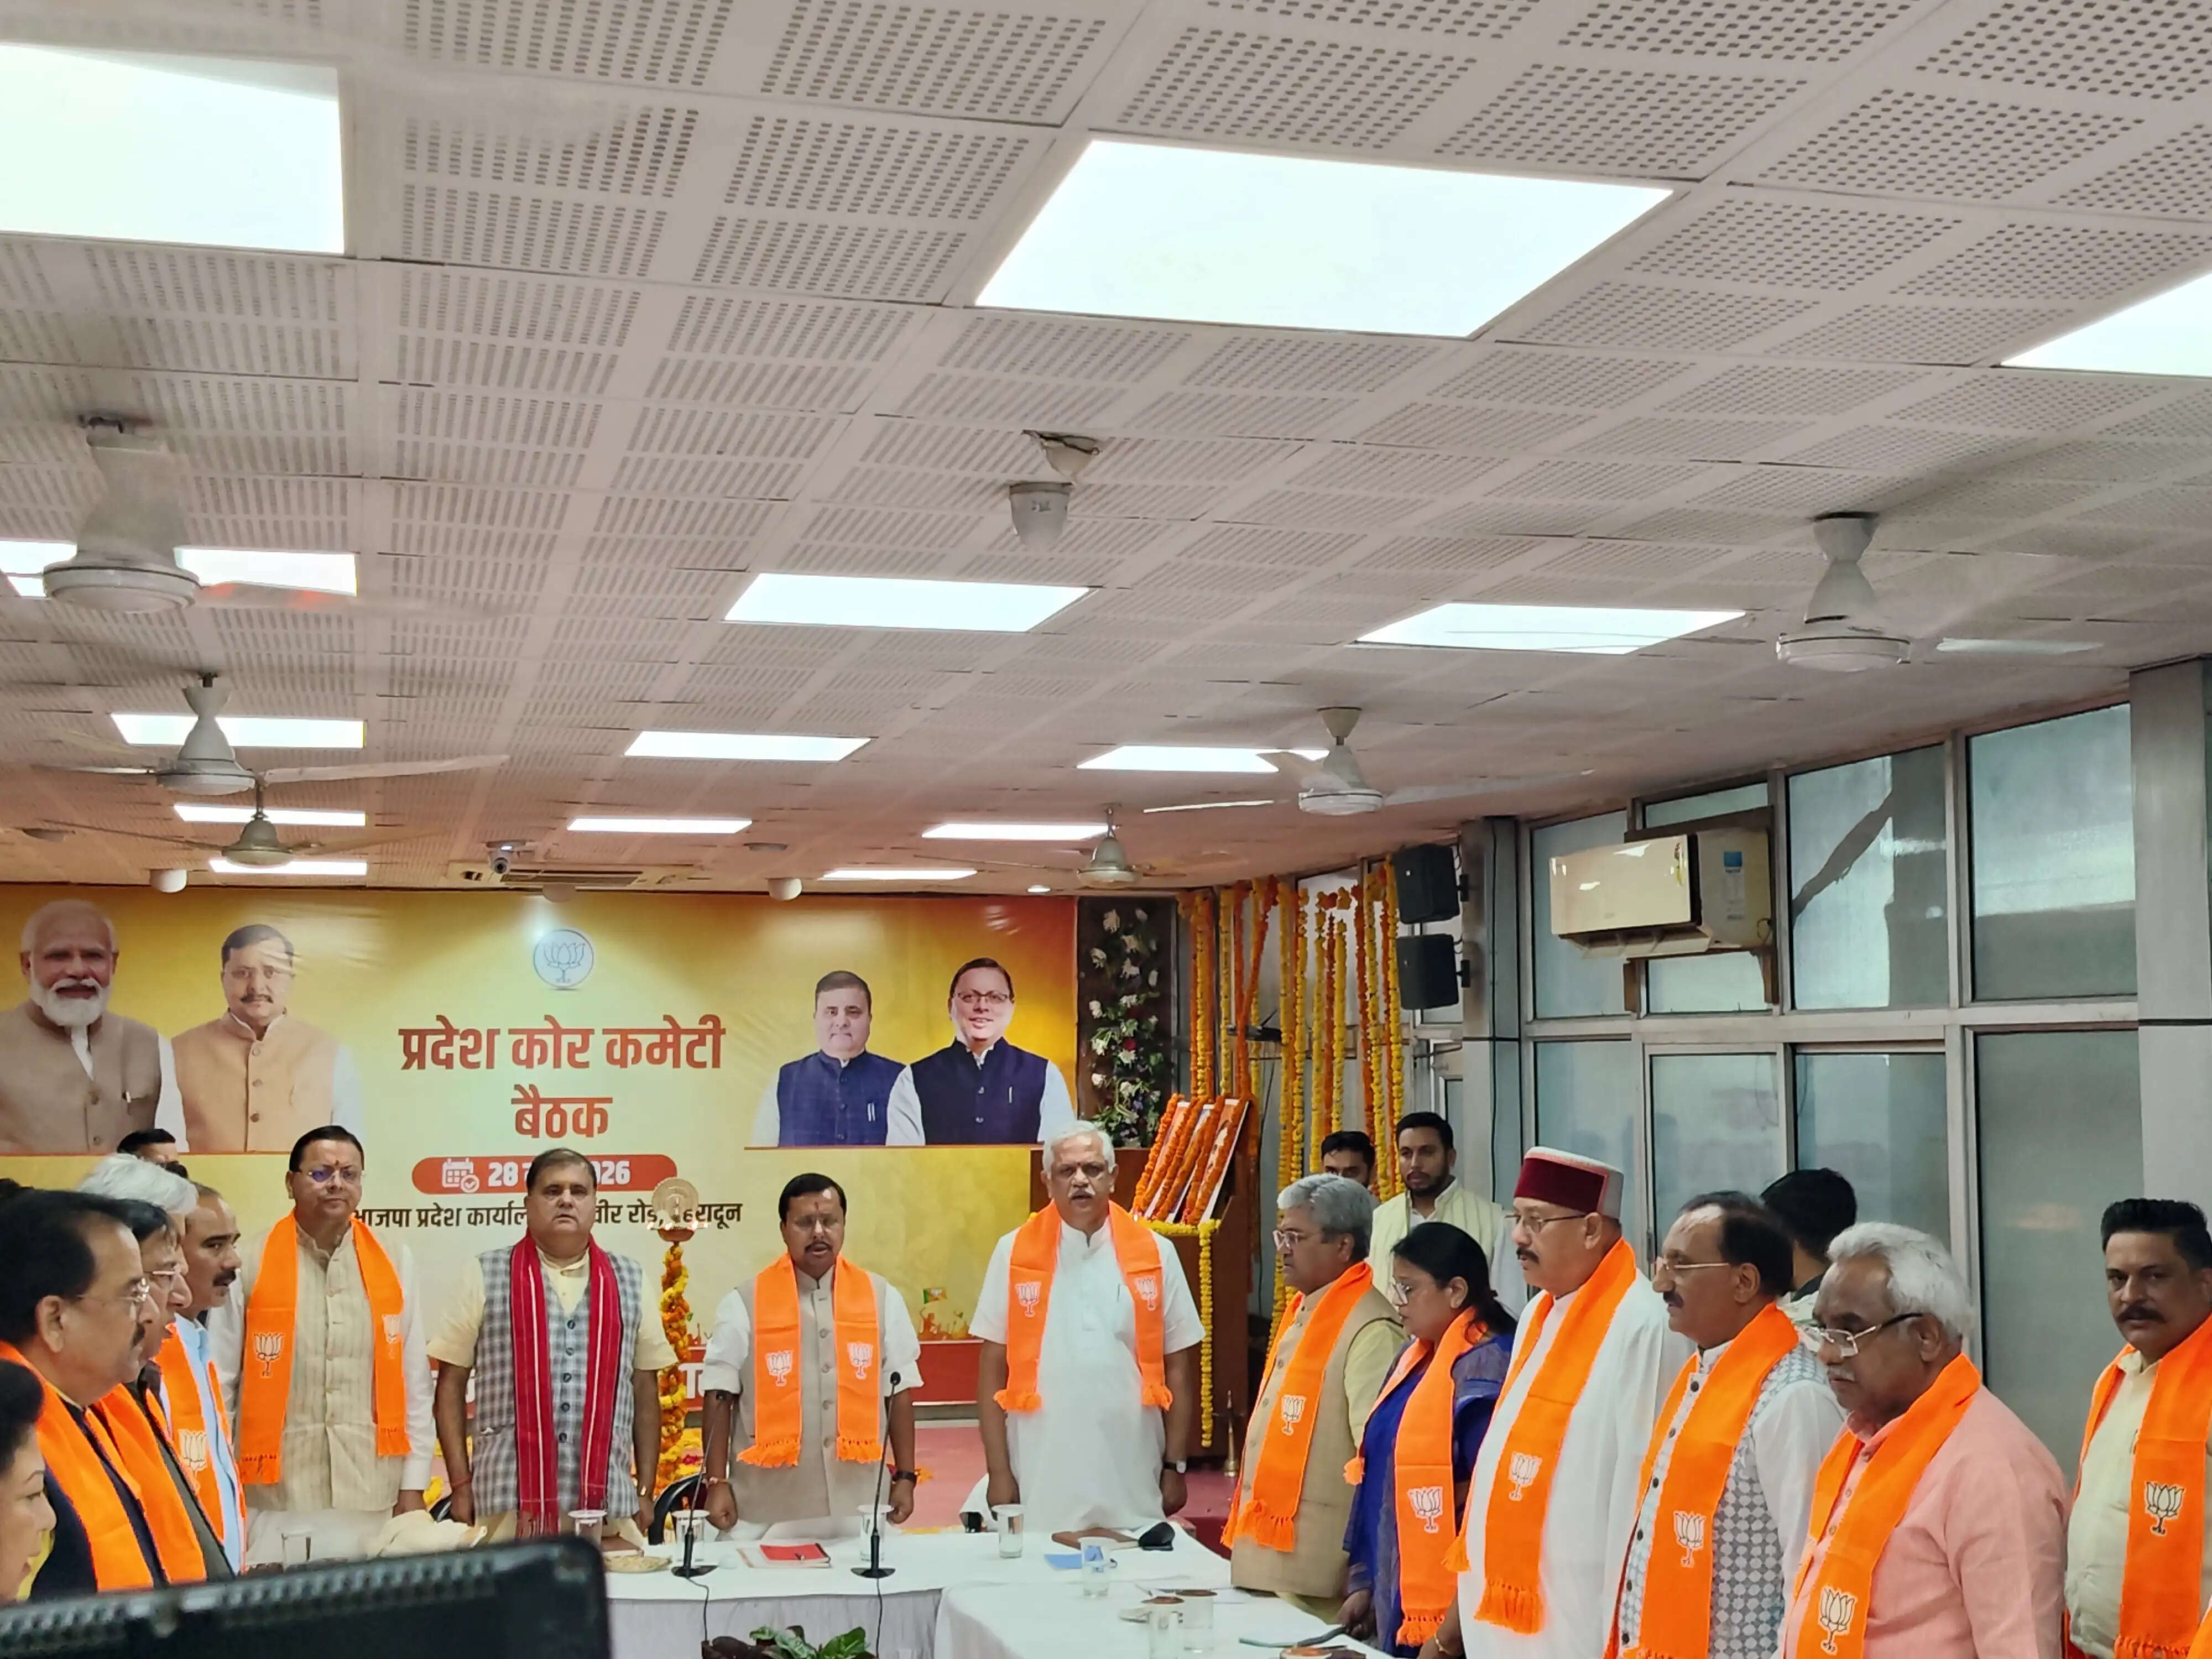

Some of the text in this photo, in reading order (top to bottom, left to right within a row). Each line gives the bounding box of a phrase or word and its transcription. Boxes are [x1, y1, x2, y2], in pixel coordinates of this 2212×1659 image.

[398, 1014, 726, 1070] प्रदेश कोर कमेटी
[510, 1084, 613, 1138] बैठक
[488, 1162, 519, 1187] 28
[416, 1202, 462, 1228] प्रदेश
[466, 1199, 527, 1226] कार्याल
